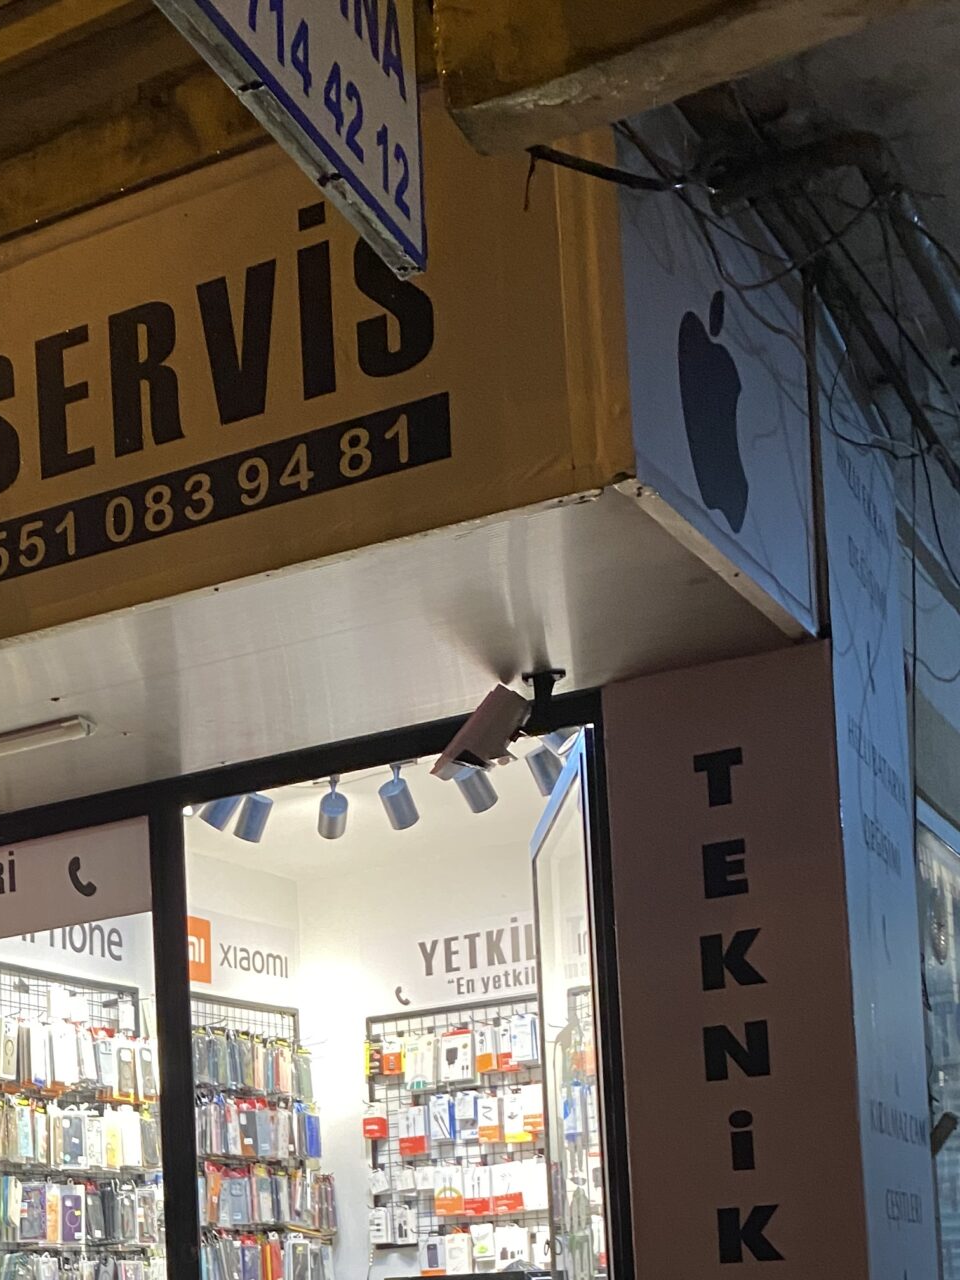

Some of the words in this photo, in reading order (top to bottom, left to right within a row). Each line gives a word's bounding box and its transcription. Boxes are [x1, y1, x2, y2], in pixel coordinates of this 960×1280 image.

[324, 61, 364, 164] 42
[377, 124, 410, 221] 12
[104, 472, 214, 543] 083
[238, 443, 315, 506] 94
[340, 413, 410, 479] 81
